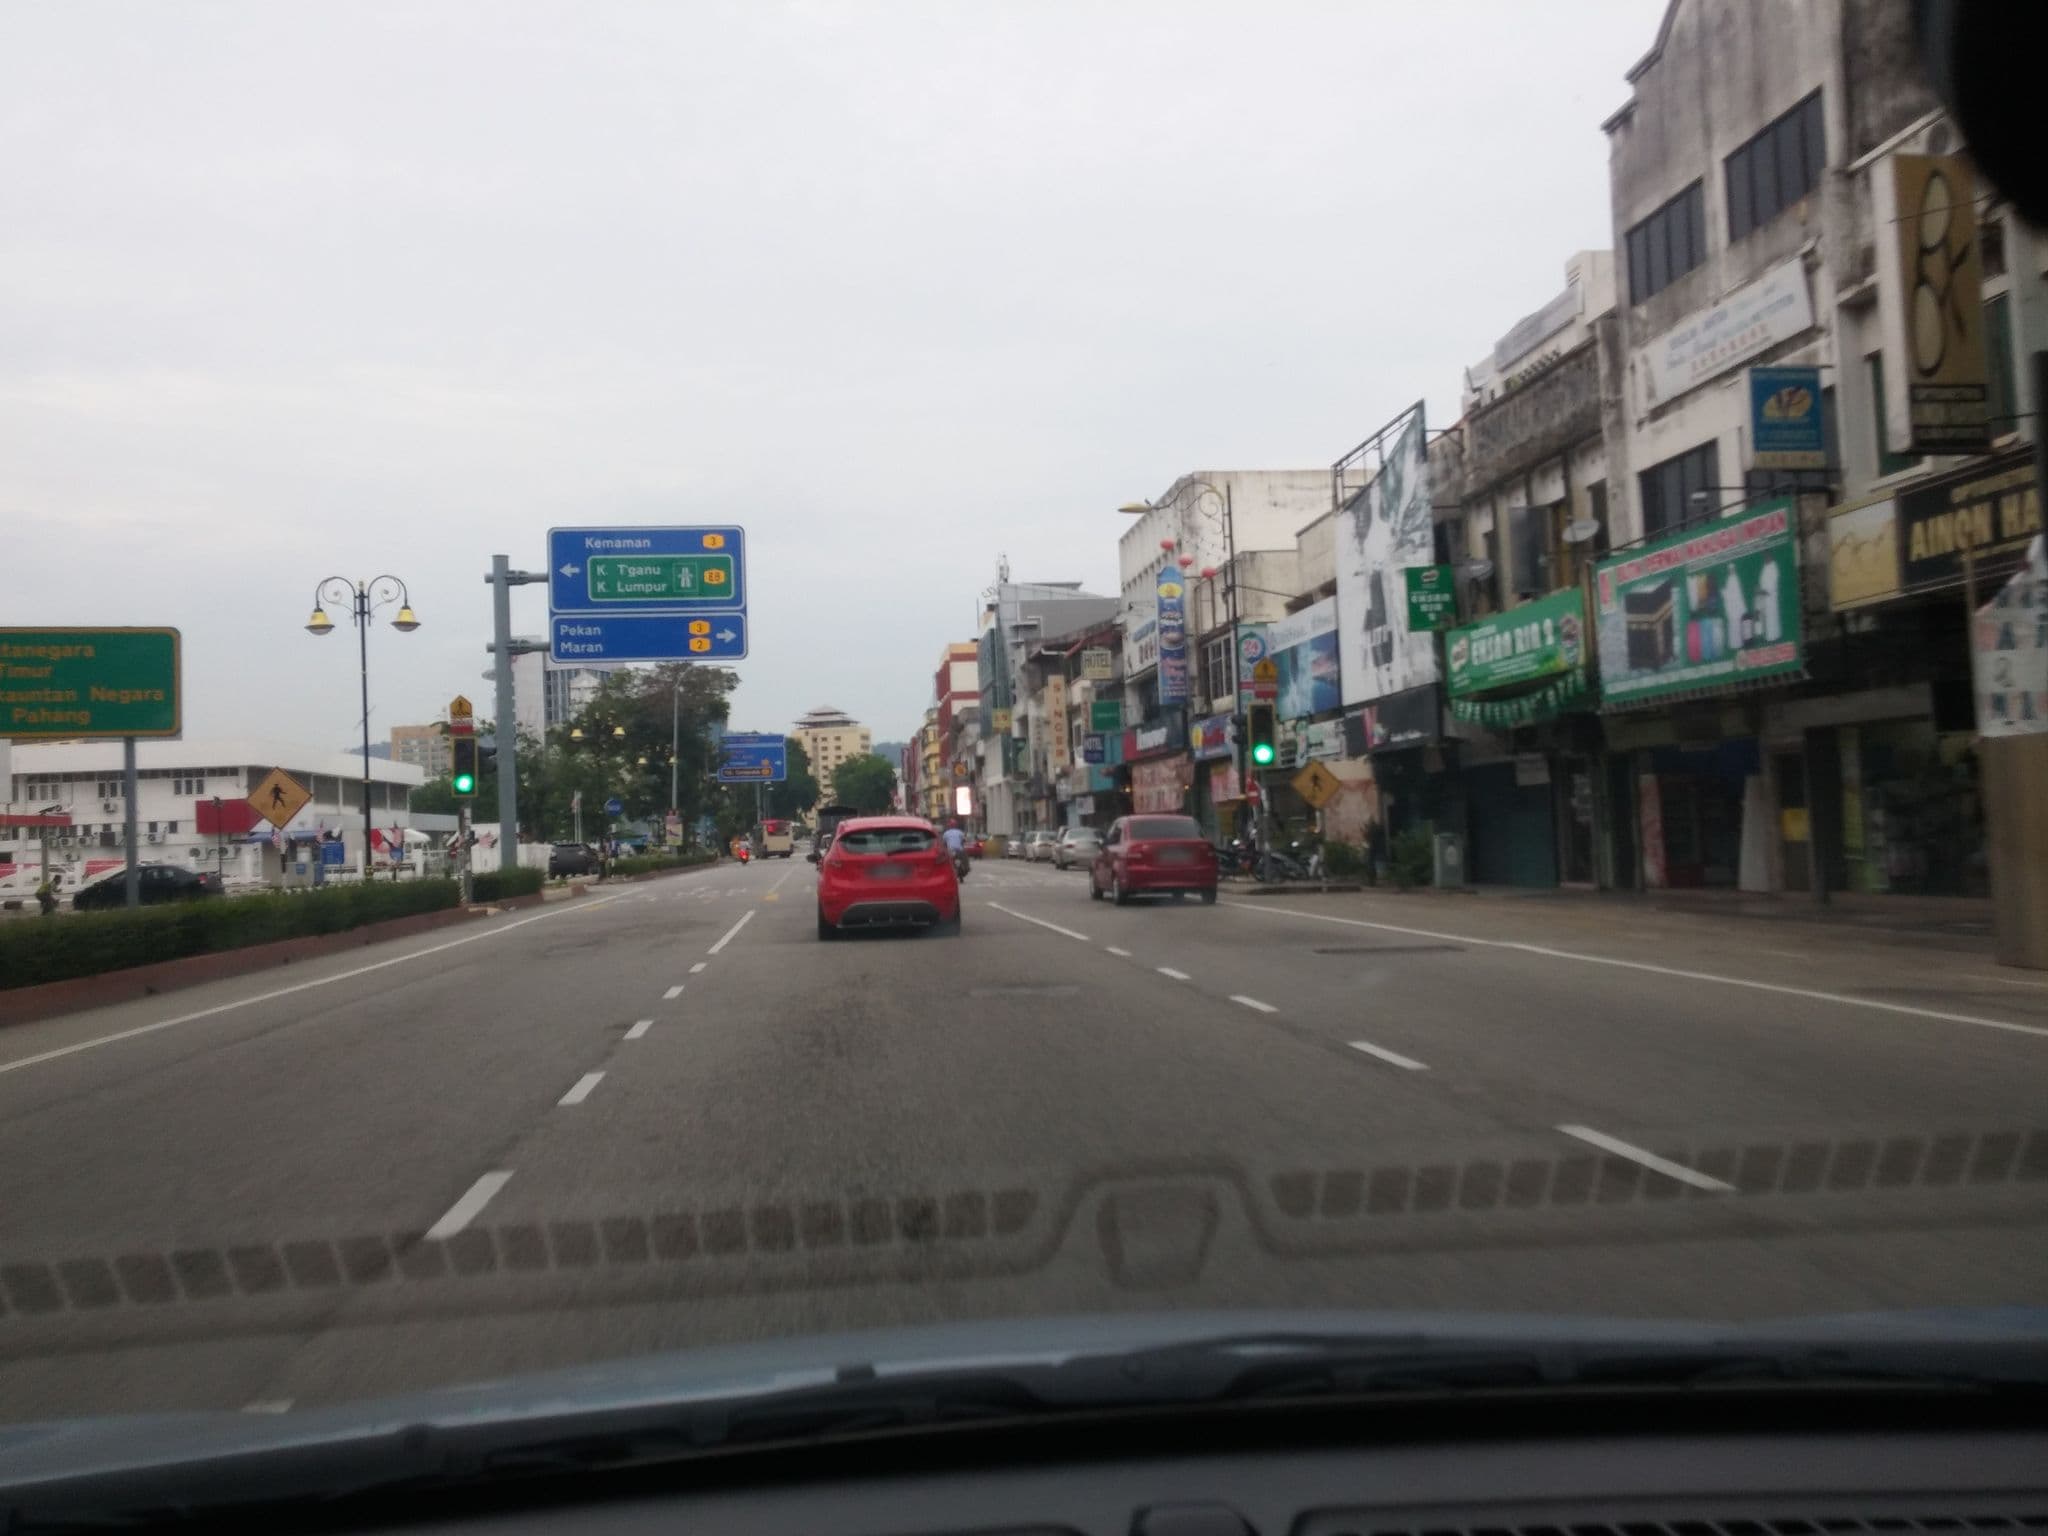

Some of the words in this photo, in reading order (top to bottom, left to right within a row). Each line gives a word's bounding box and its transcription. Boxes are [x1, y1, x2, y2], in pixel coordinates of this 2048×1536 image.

[585, 537, 651, 549] Kemaman
[616, 582, 668, 594] Lumpur
[559, 624, 601, 636] Pekan
[559, 641, 604, 653] Maran
[90, 687, 164, 704] Negara
[12, 707, 91, 725] Pahang
